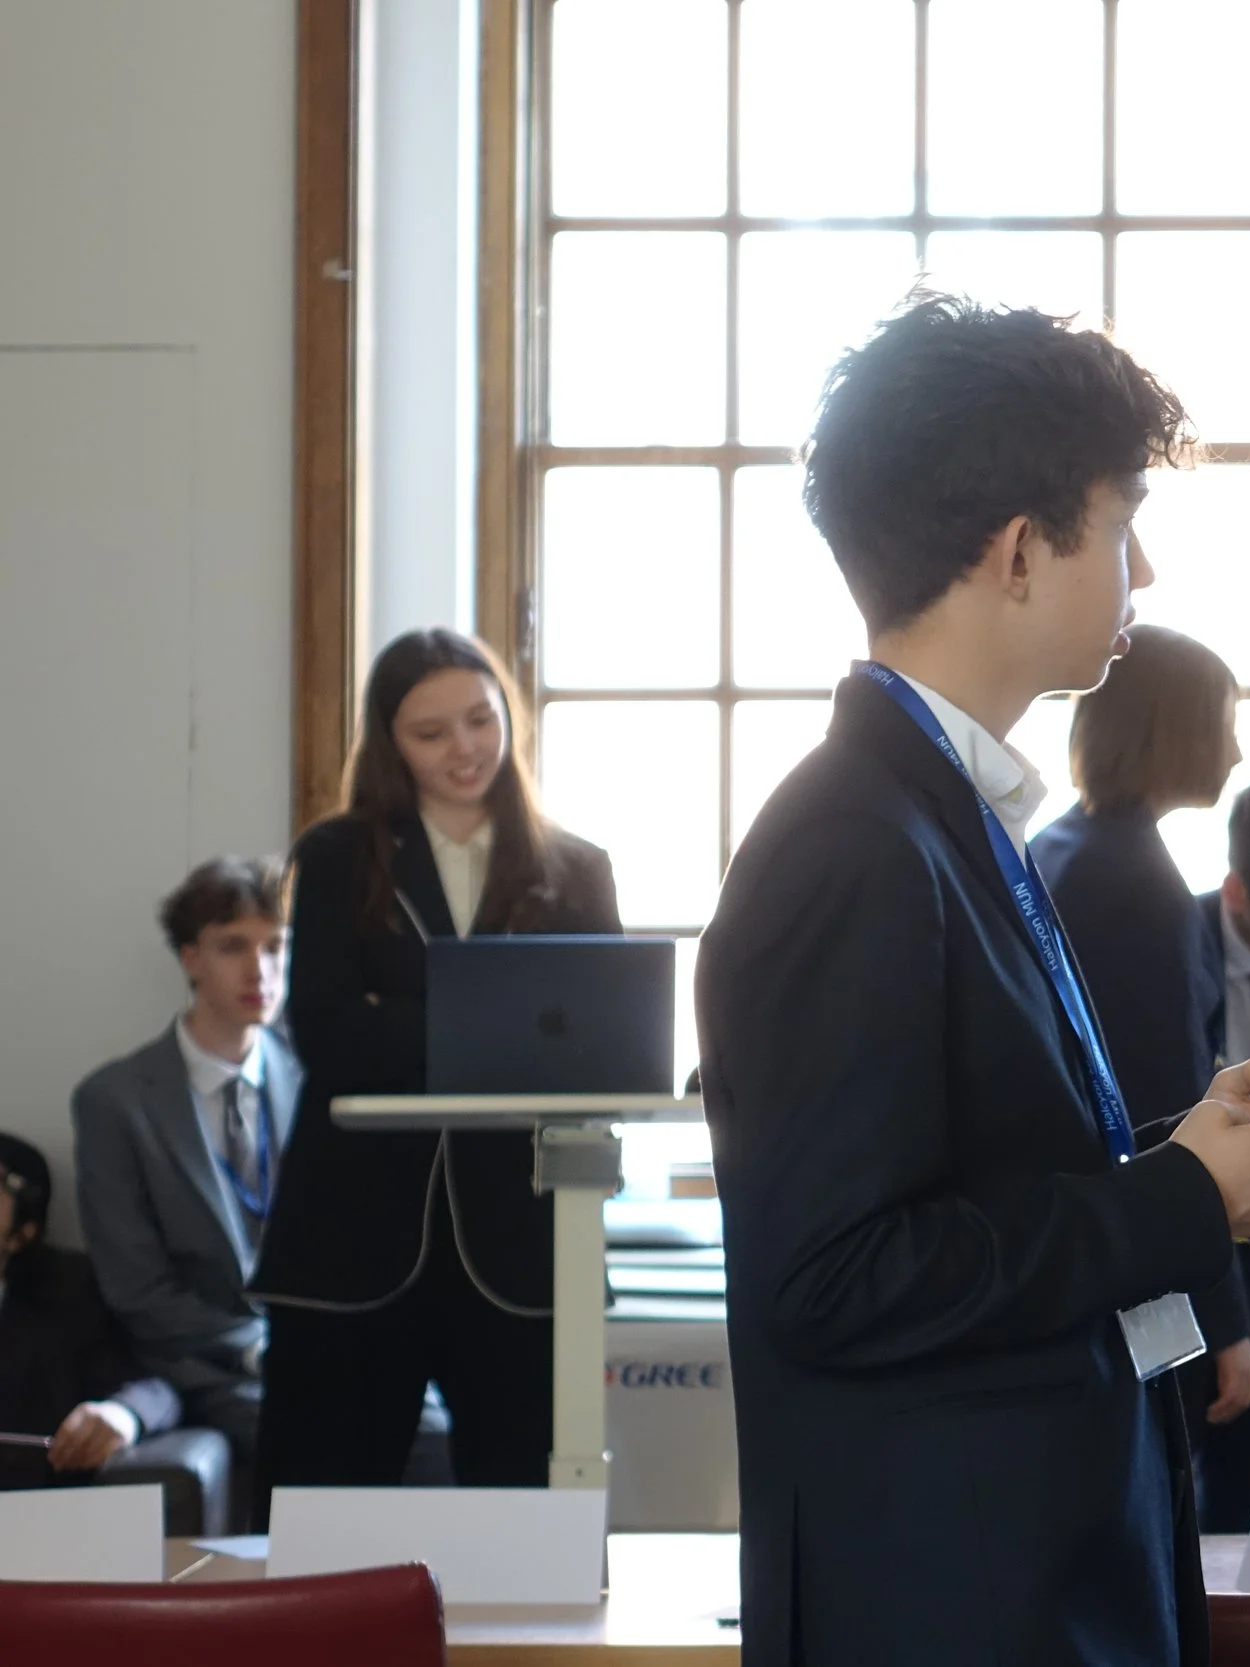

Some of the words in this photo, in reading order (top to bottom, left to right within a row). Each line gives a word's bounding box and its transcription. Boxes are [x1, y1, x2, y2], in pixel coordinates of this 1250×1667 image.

[937, 735, 961, 766] MUN
[1013, 881, 1038, 917] MUN
[1032, 917, 1059, 971] Halcyon
[619, 1365, 724, 1389] GREE
